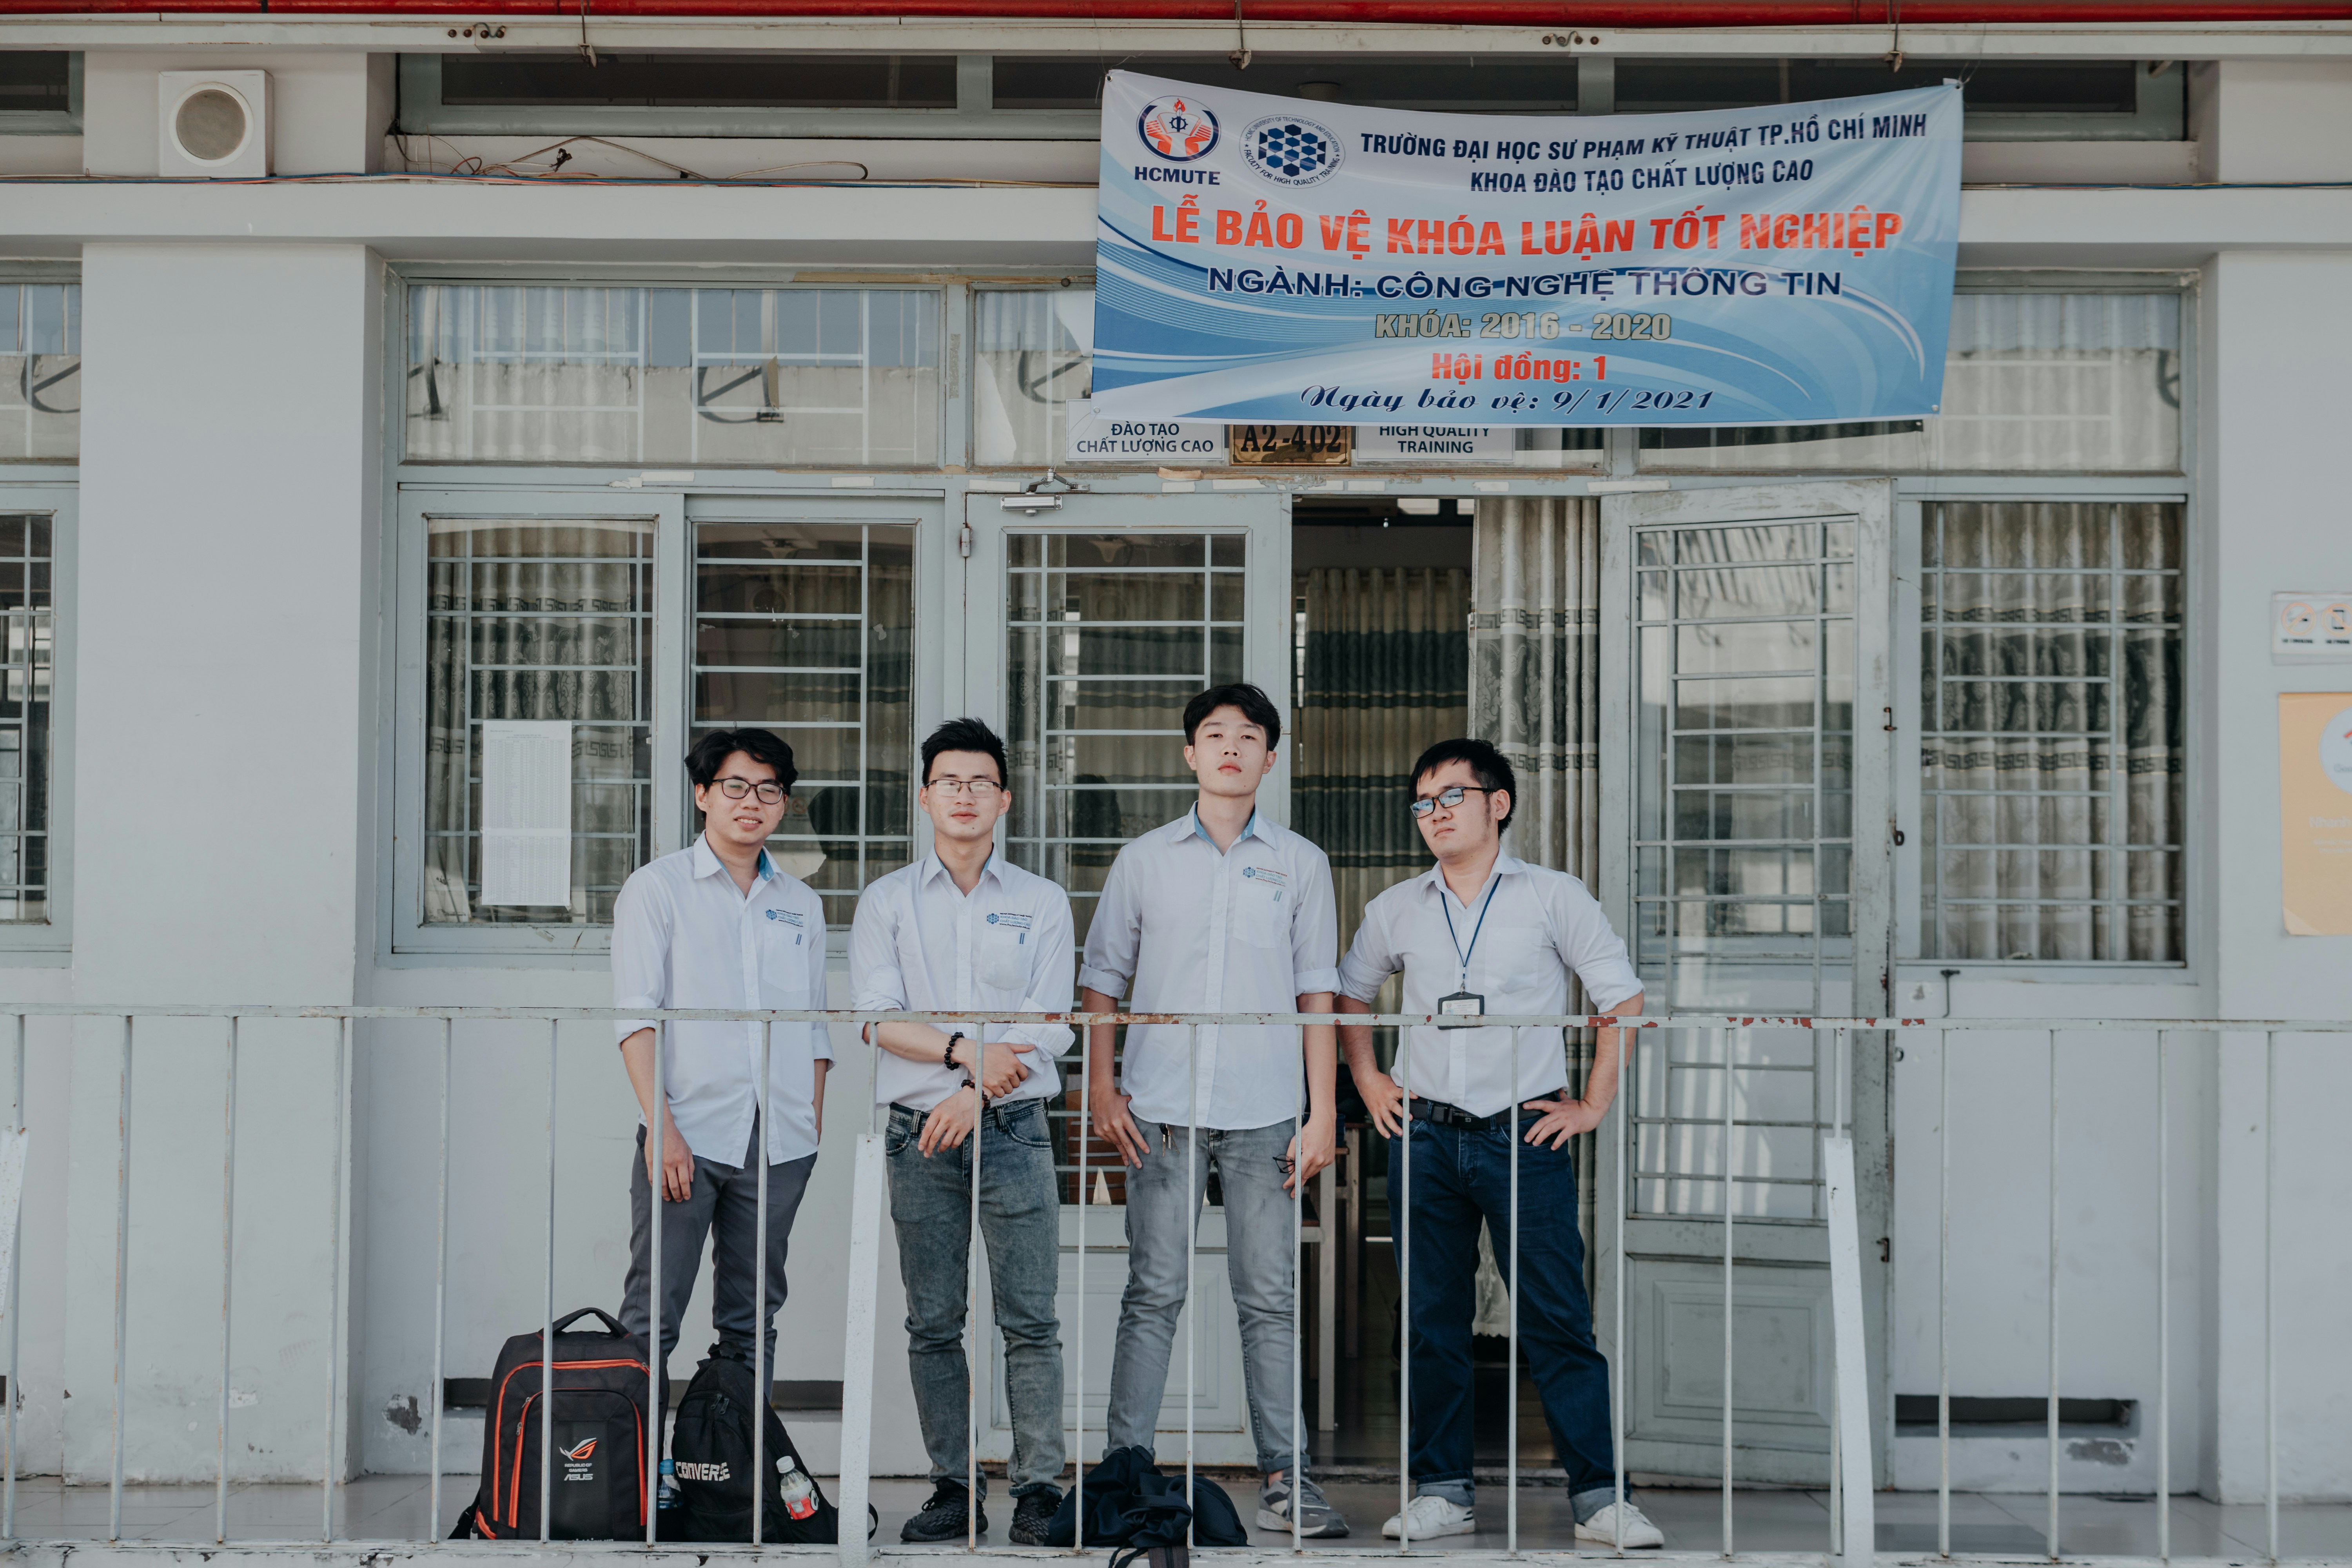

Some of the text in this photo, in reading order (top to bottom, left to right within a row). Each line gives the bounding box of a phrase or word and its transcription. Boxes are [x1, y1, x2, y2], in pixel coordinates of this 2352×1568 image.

[1254, 118, 1274, 130] UNIVERSITY
[1283, 117, 1315, 127] TECHNOLOGY
[1323, 131, 1340, 152] EDUCATION
[1361, 113, 1926, 164] TRƯỜNG ĐẠI HỌC SƯ PHẠM KỸ THUẬT TP.HỒ CHÍ MINH
[1135, 167, 1220, 185] HCMUTE
[1244, 150, 1340, 186] FACULTY FOR HIGH QUALITY TRAINING
[1471, 159, 1813, 195] KHOA ĐÀO TẠO CHẤT LƯỢNG CAO
[1152, 194, 1901, 260] LỄ BẢO VỆ KHÓA LUẬN TỐT NGHIỆP
[1209, 265, 1840, 301] NGÀNH: CÔNG NGHỆ THÔNG TIN
[1376, 309, 1470, 338] KHÓA:
[1480, 312, 1559, 339] 2016
[1592, 313, 1671, 341] 2020
[1432, 351, 1605, 385] Hội đồng: 1
[1301, 385, 1405, 412] Ngày
[1417, 388, 1478, 409] bảo
[1491, 392, 1538, 414] vệ:
[1111, 421, 1180, 439] ĐÀO TẠO
[1240, 425, 1341, 453] A2-402
[1379, 426, 1418, 436] HIGH
[1077, 437, 1213, 456] CHẤT LƯỢNG CAO
[1398, 441, 1473, 453] TRAINING
[675, 1462, 730, 1481] CONVERSE
